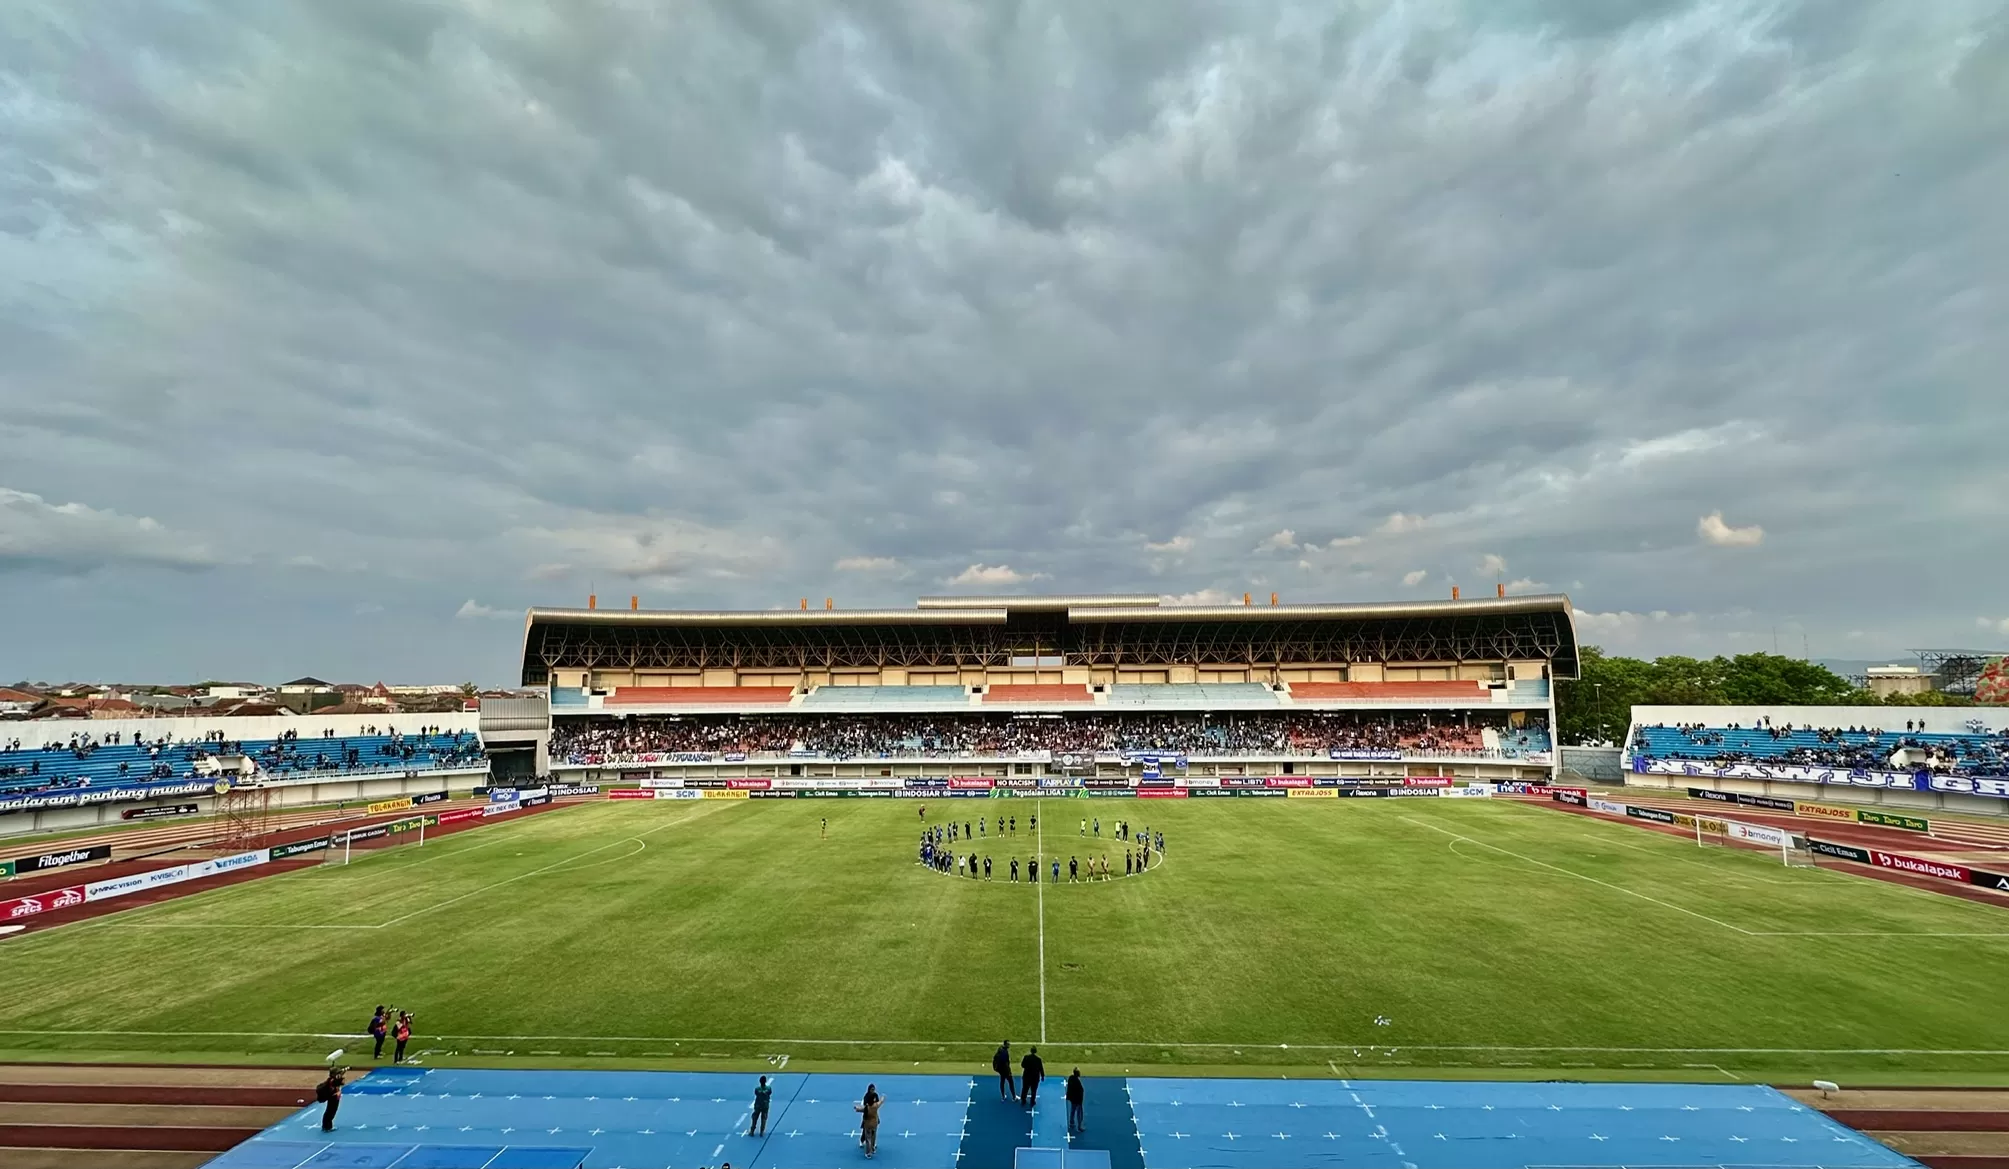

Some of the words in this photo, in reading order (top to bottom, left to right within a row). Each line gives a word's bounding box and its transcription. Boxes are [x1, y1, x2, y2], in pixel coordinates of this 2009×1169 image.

[557, 786, 598, 796] INDOSIAR
[676, 790, 696, 798] SCM
[902, 790, 941, 798] INDOSIAR
[1012, 790, 1045, 798] Pegadaian
[1045, 789, 1062, 797] LIGA
[1061, 789, 1067, 797] 2
[1355, 789, 1378, 797] Rexona
[1398, 789, 1439, 797] INDOSIAR
[1462, 788, 1485, 797] SCM
[1704, 791, 1727, 801] Rexona
[495, 804, 507, 813] nex
[507, 802, 519, 811] nex
[1862, 812, 1881, 822] Taro
[1882, 815, 1902, 826] Taro
[1903, 819, 1924, 829] Taro
[1748, 831, 1781, 844] bmoney
[314, 840, 328, 848] Emas
[1819, 844, 1837, 855] Cicil
[1836, 848, 1858, 859] Emas
[38, 851, 90, 868] Fitogether
[1894, 858, 1962, 879] bukalapak
[53, 897, 82, 908] SPECS
[11, 905, 42, 916] SPECS
